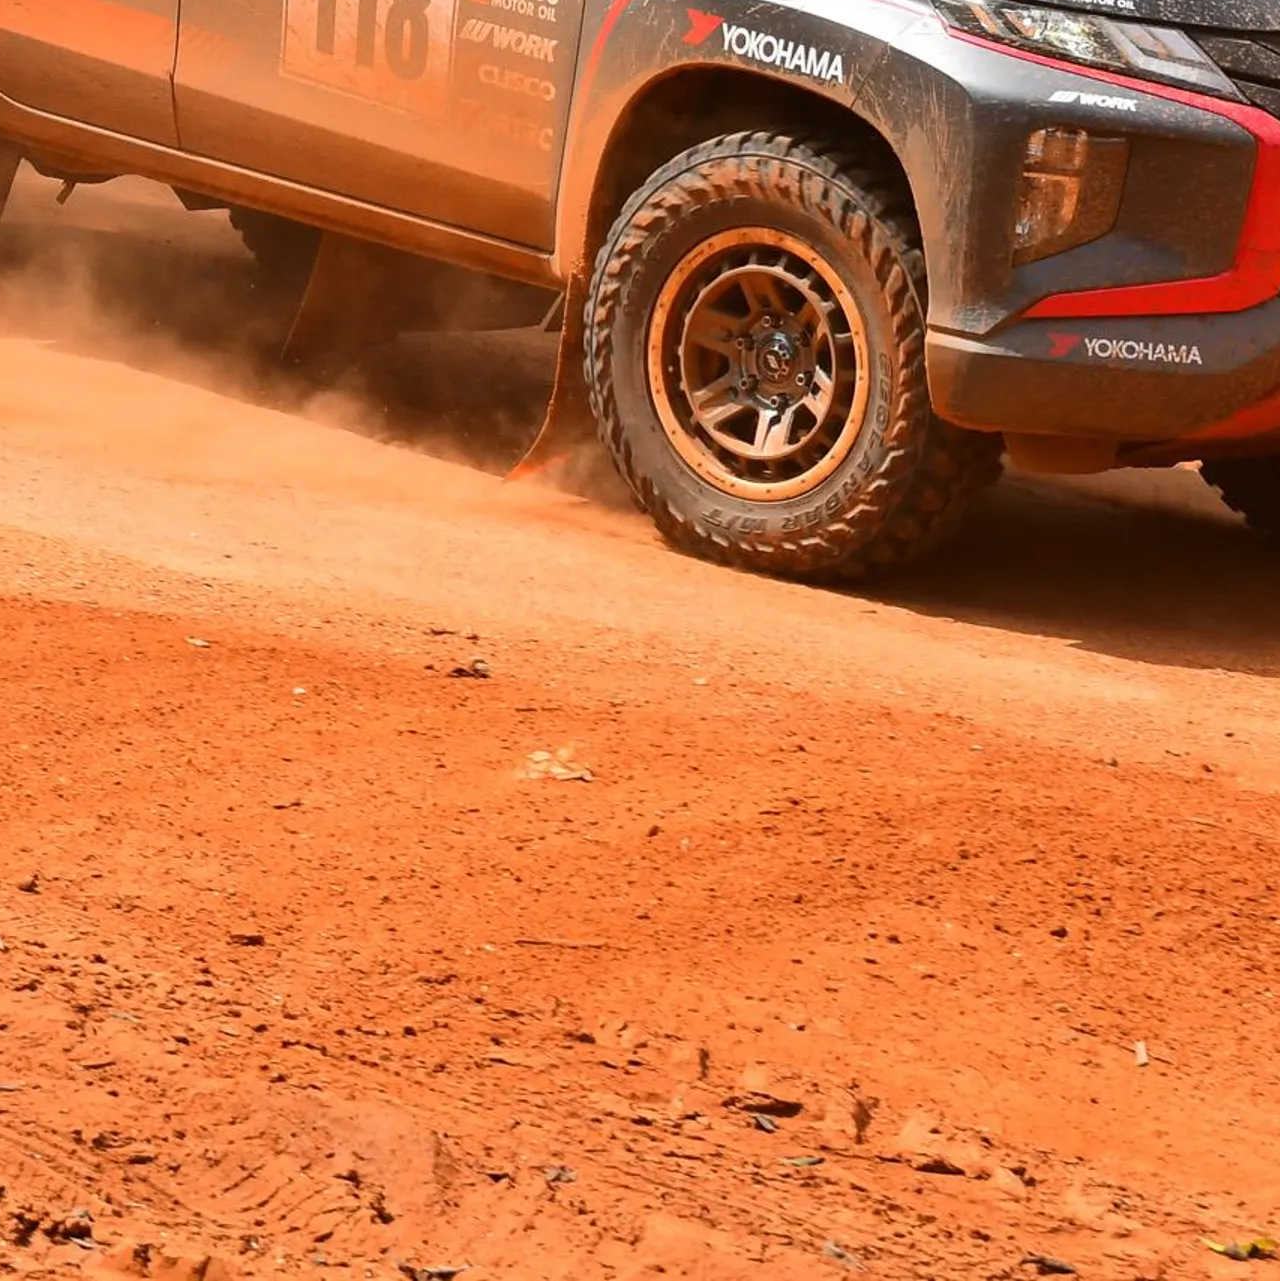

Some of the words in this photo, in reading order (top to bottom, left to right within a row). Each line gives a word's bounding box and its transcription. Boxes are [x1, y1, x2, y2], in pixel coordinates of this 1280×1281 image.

[537, 6, 557, 23] OIL
[1117, 0, 1136, 10] OIL
[721, 23, 844, 84] YOKOHAMA
[1079, 93, 1139, 112] WORK
[1084, 336, 1203, 365] YOKOHAMA
